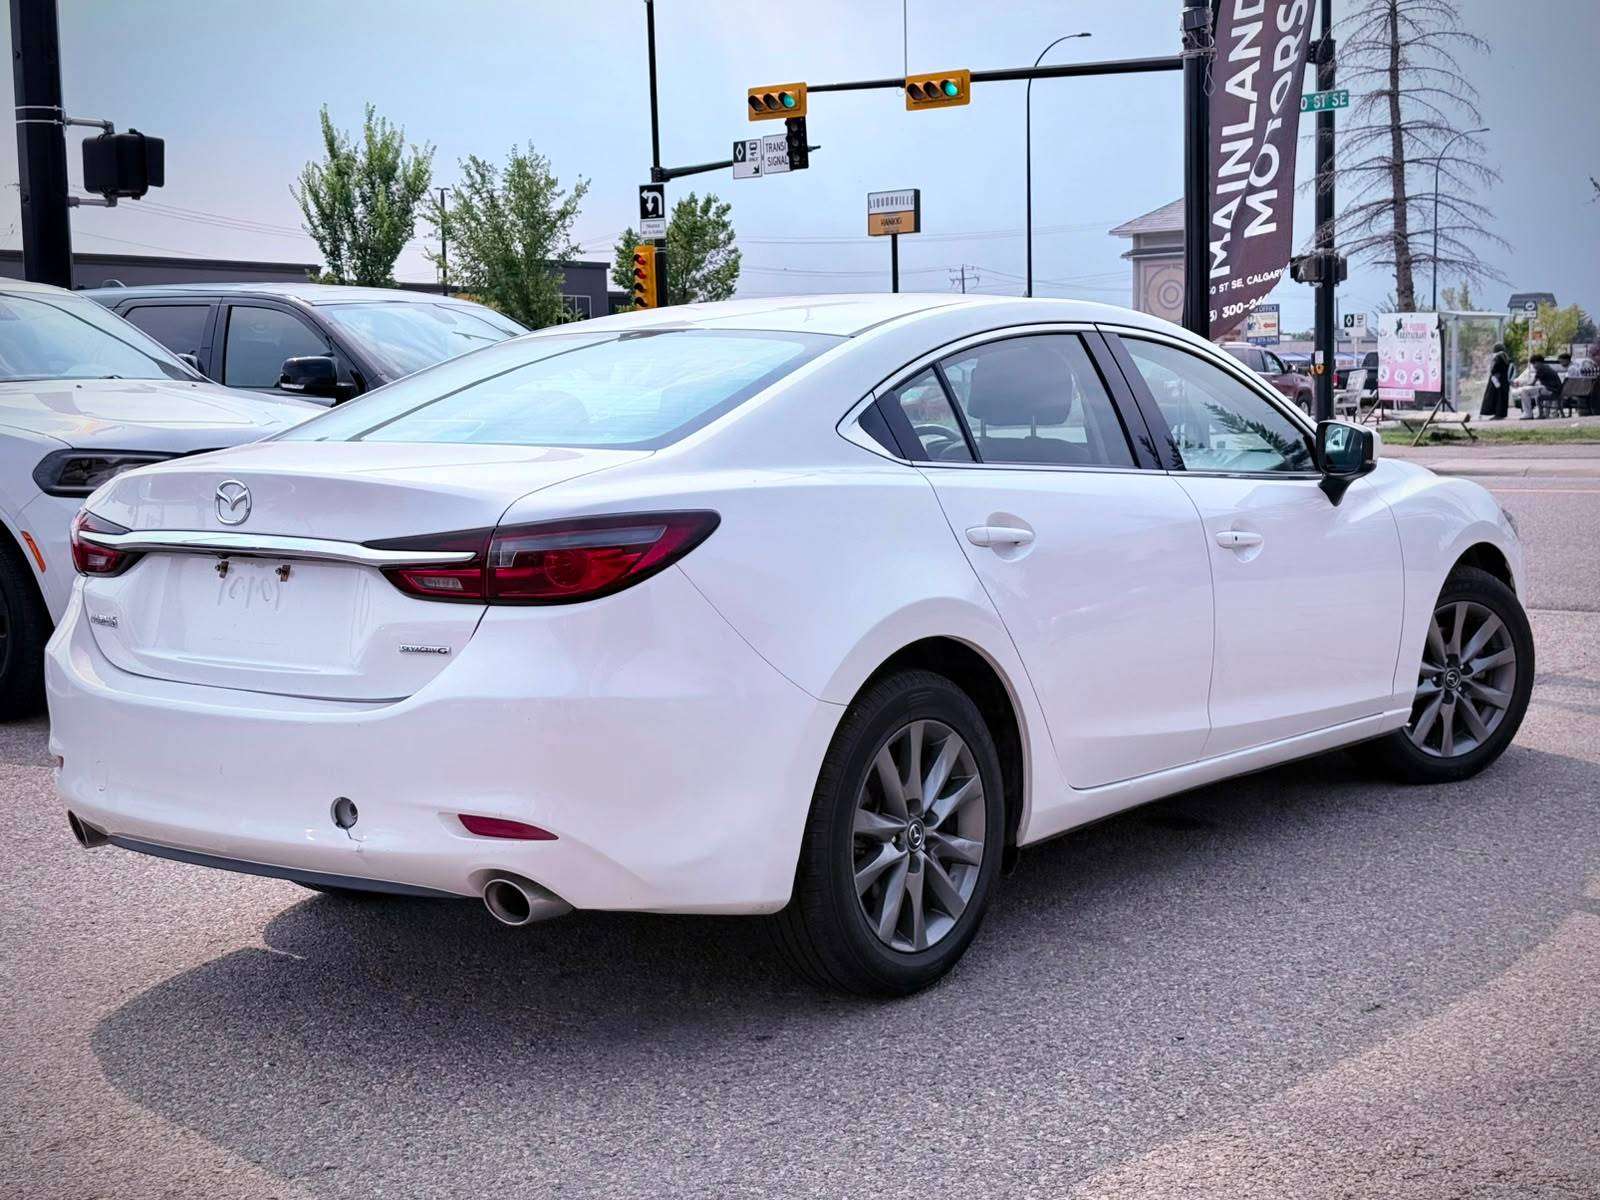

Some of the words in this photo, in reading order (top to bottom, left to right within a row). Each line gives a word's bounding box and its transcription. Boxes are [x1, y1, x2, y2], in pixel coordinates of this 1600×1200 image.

[1313, 94, 1326, 109] ST
[1332, 91, 1347, 107] SE
[1243, 0, 1309, 238] MOTORS
[765, 141, 787, 153] TRANSI
[767, 154, 789, 167] SIGNAL
[1219, 282, 1229, 293] ST
[1246, 267, 1285, 285] CALGARY
